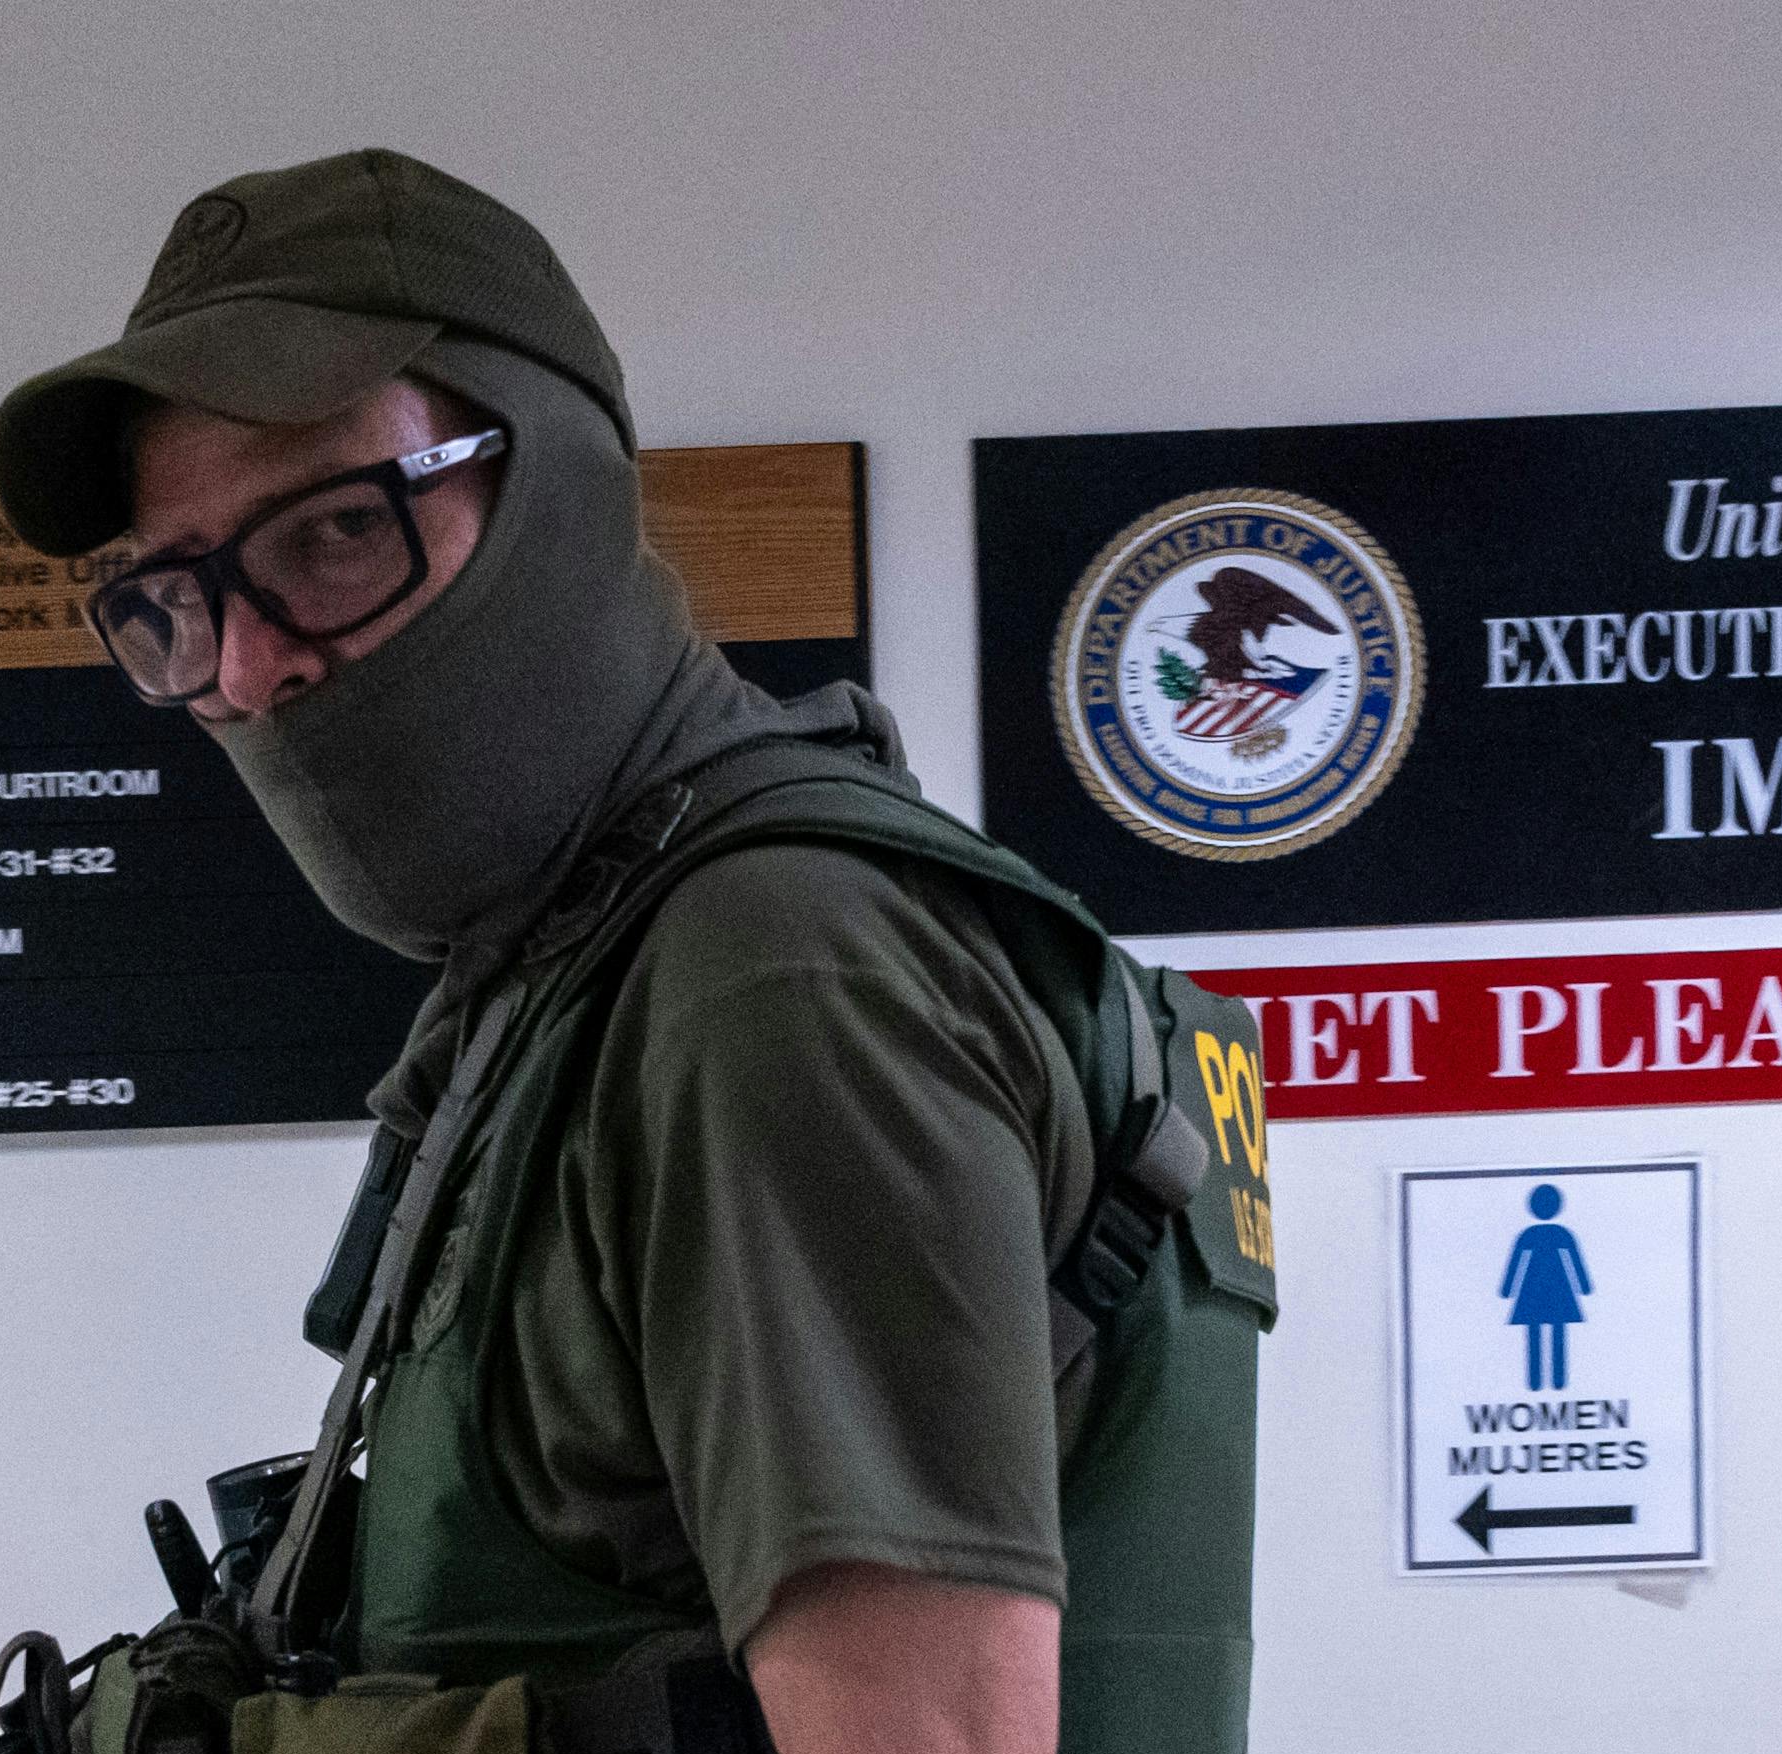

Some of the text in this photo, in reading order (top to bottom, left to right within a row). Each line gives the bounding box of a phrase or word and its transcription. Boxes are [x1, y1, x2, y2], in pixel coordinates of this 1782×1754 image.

[1083, 519, 1257, 705] DEPARTMENT
[1264, 520, 1320, 559] OF
[1316, 548, 1395, 692] JUSTICE
[1465, 1398, 1630, 1434] WOMEN
[1447, 1440, 1649, 1476] MUJERES
